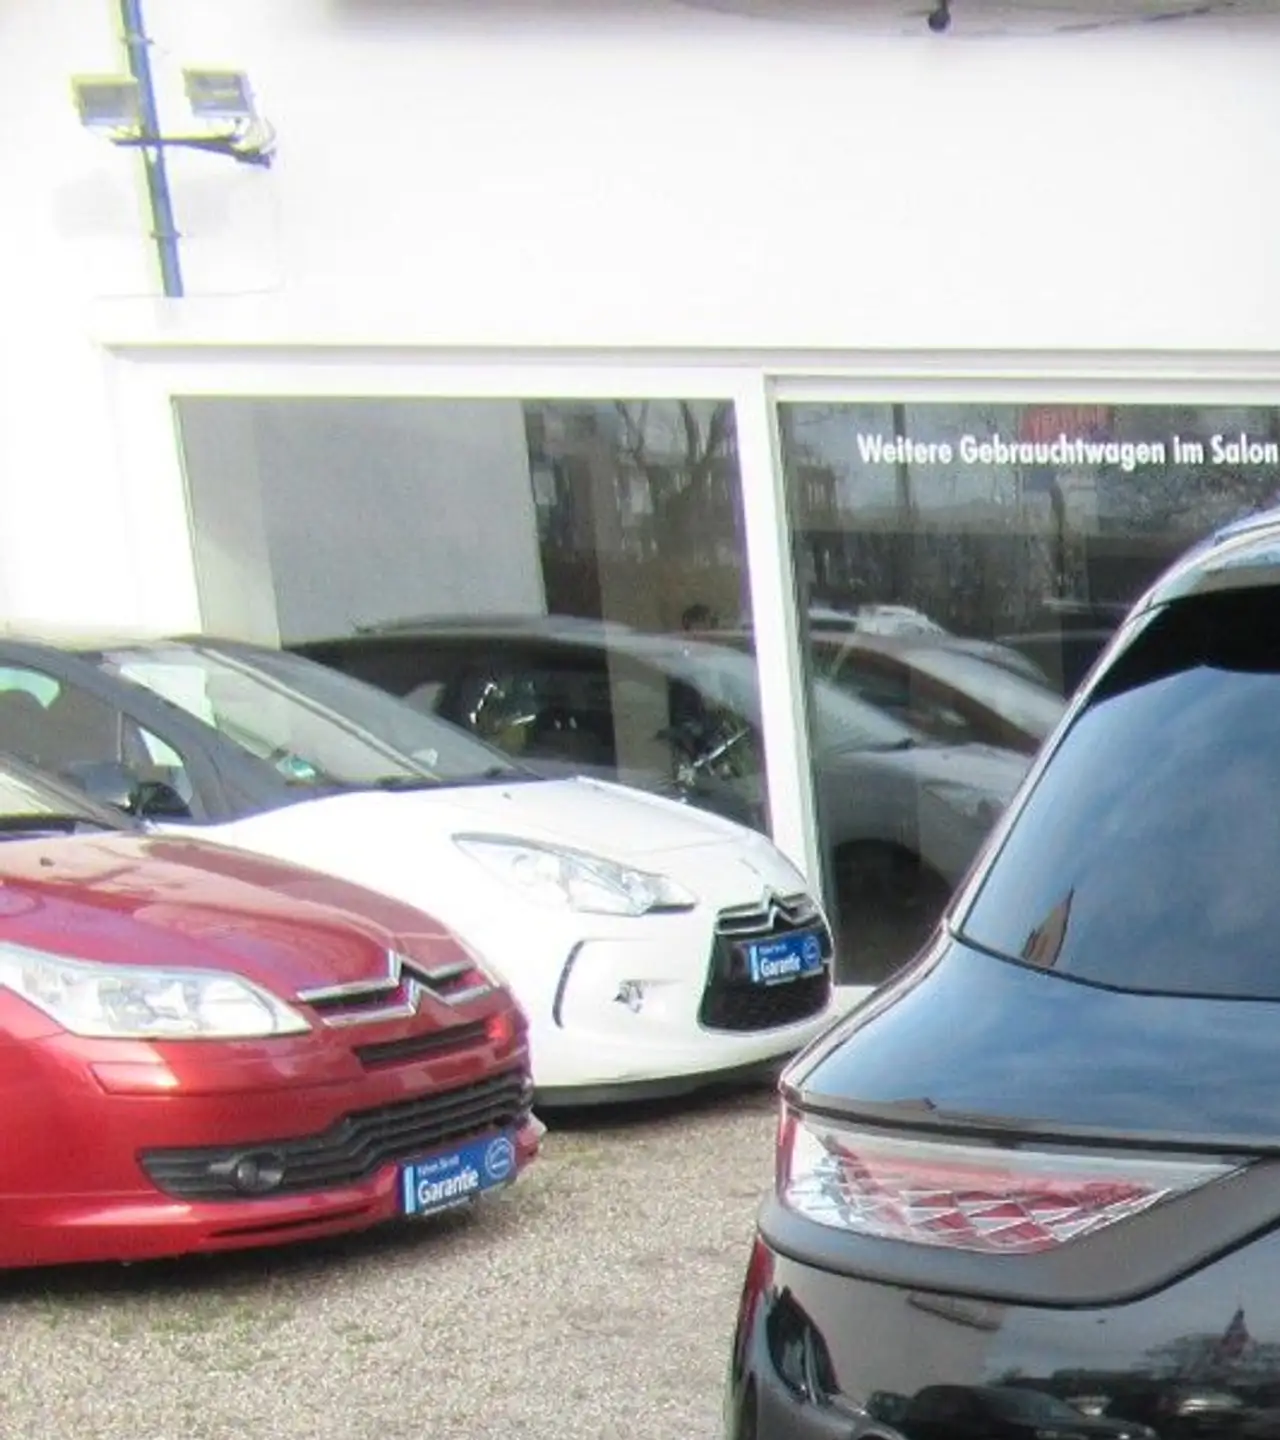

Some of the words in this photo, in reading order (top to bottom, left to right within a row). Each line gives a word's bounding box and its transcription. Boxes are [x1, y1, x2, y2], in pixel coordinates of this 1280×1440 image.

[857, 433, 952, 464] Weitere
[960, 433, 1165, 471] Gebrauchtwagen
[1173, 434, 1204, 464] im
[1211, 432, 1279, 464] Salon
[417, 1165, 479, 1204] Garantie
